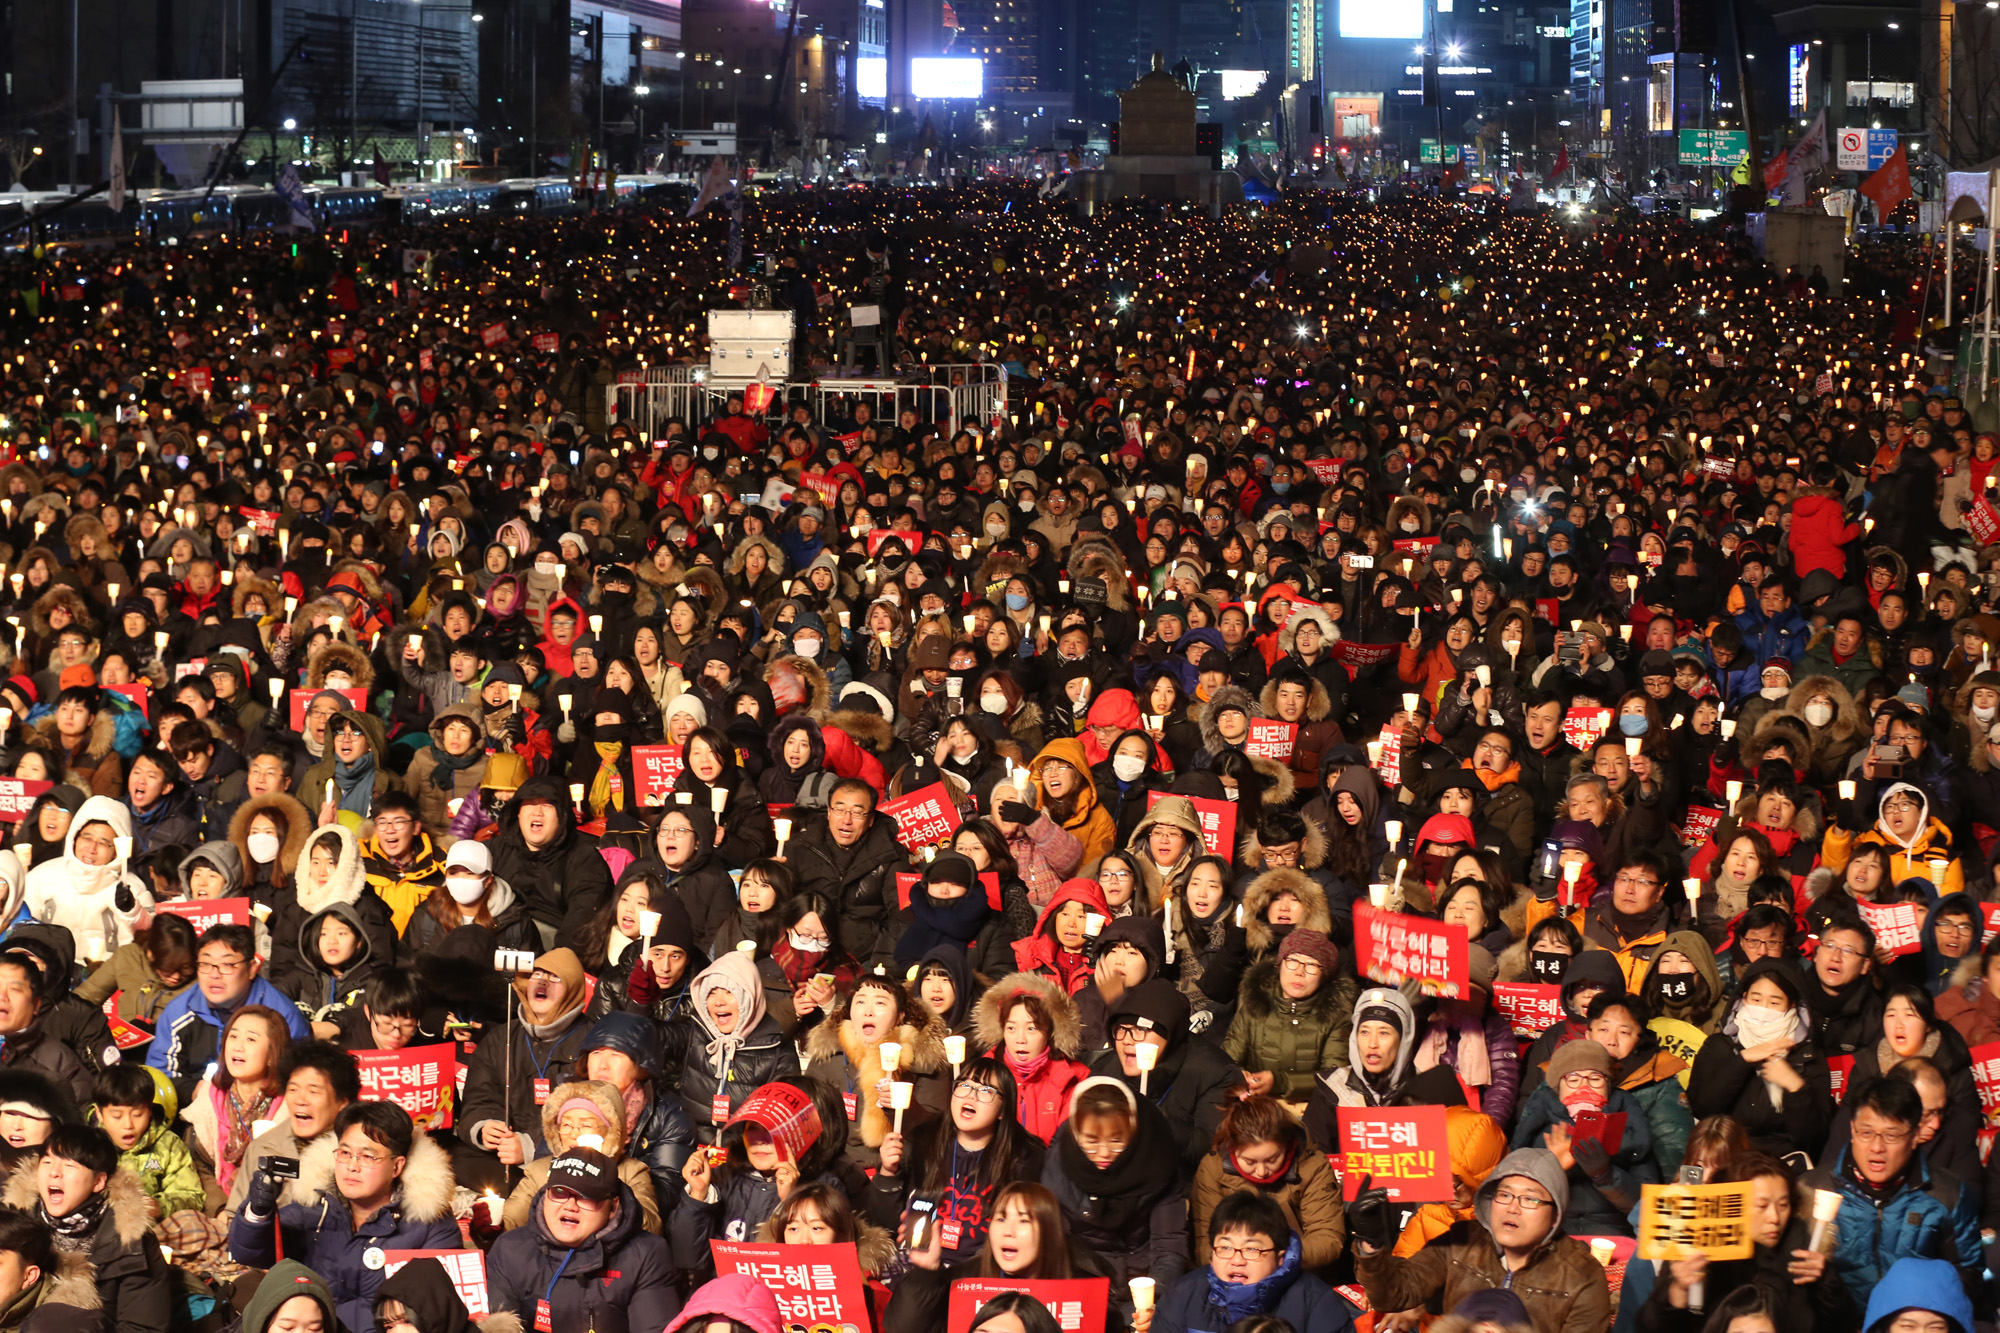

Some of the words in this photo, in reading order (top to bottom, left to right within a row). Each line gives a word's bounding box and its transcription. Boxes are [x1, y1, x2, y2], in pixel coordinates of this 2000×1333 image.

[1562, 716, 1600, 731] 근혜를
[1253, 725, 1289, 742] 박근혜
[1246, 742, 1293, 759] 즉각퇴진
[1686, 812, 1720, 828] 근혜를
[1370, 920, 1449, 957] 박근혜를
[360, 1062, 439, 1090] 박근혜를
[713, 1108, 728, 1116] OUT!
[1349, 1121, 1418, 1149] 박근혜
[1346, 1149, 1435, 1180] 즉각퇴진!
[942, 1232, 958, 1242] OUT!
[716, 1244, 738, 1254] 나눔문화
[739, 1247, 780, 1256] www.nanum.com
[735, 1261, 837, 1291] 박근혜를
[957, 1283, 983, 1291] 나눔문화
[779, 1294, 842, 1321] 속하라
